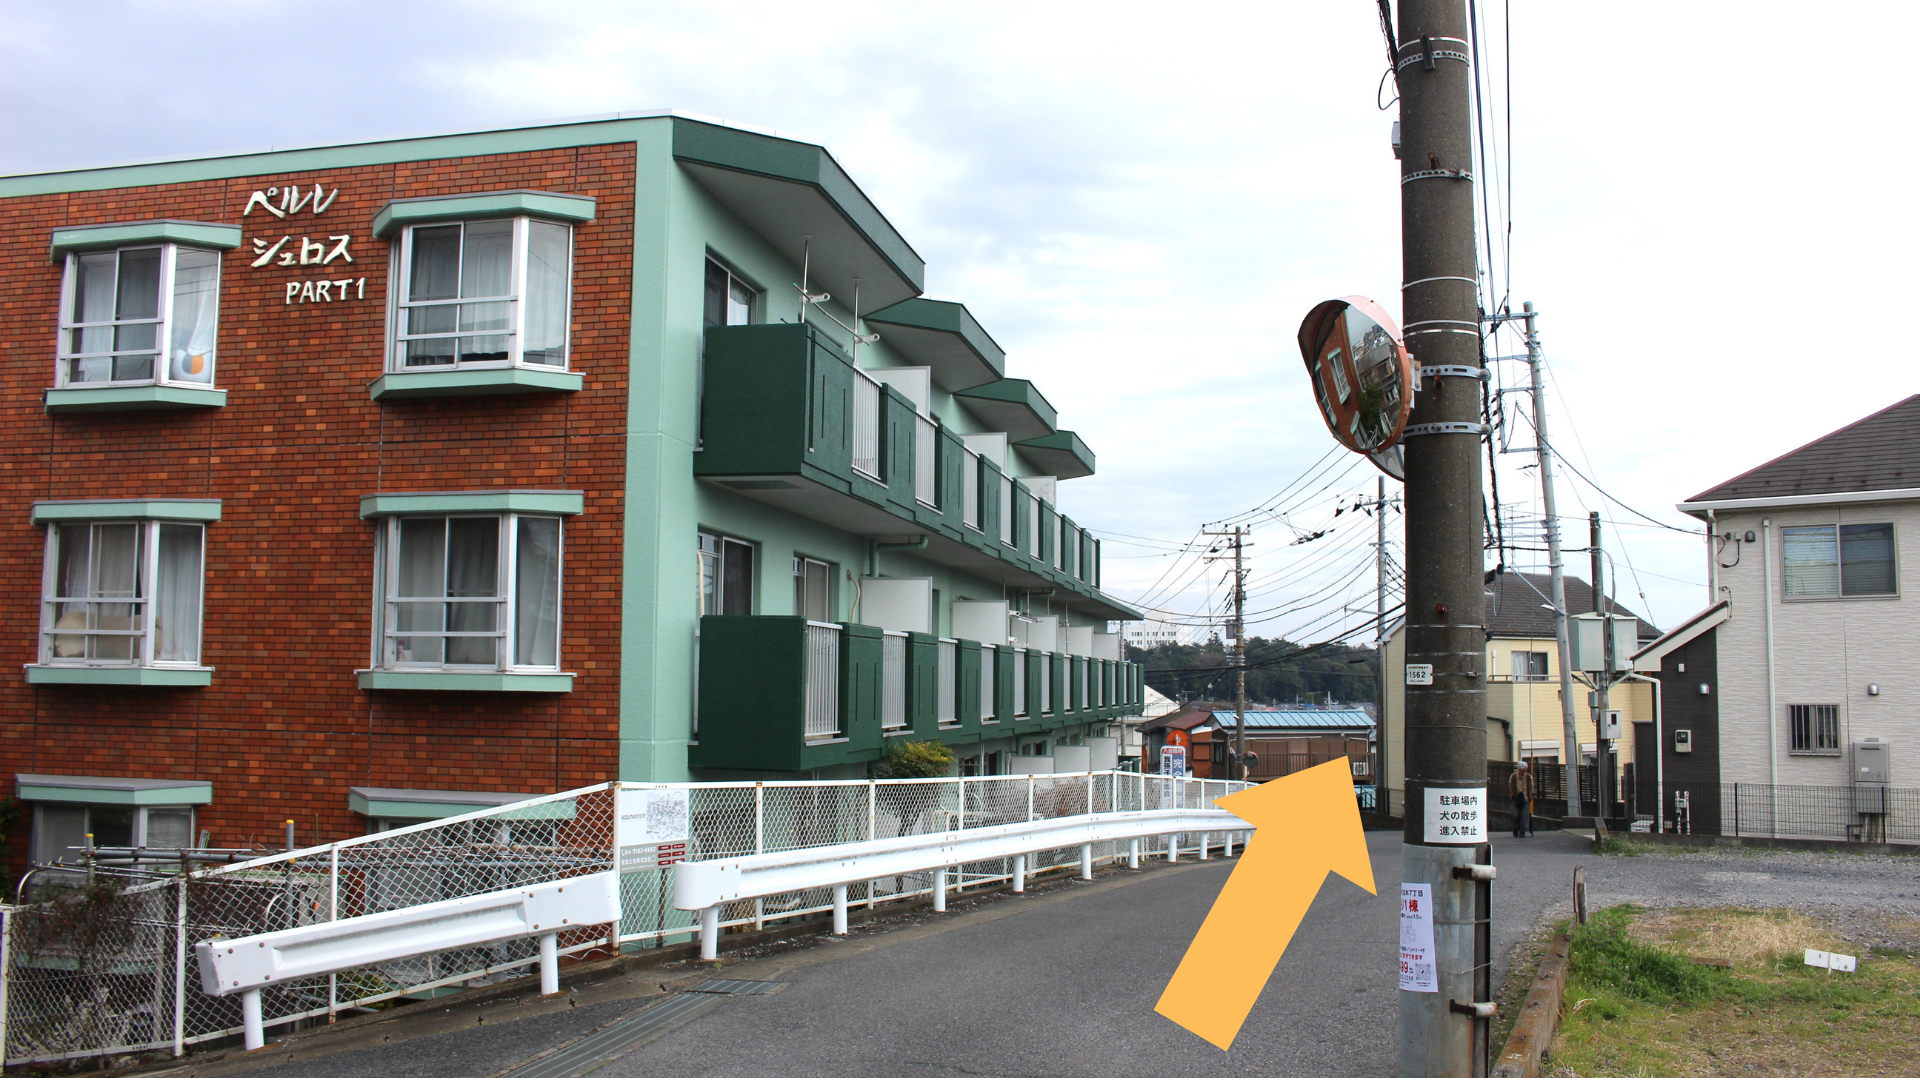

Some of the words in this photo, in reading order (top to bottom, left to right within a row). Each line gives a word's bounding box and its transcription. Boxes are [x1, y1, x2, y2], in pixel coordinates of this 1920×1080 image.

[243, 183, 339, 219] ペルレ
[251, 234, 353, 268] シュロス
[1409, 671, 1426, 679] 1562
[1439, 795, 1478, 806] 駐車場内
[1439, 810, 1478, 821] 犬の散歩
[1439, 825, 1478, 836] 進入禁止
